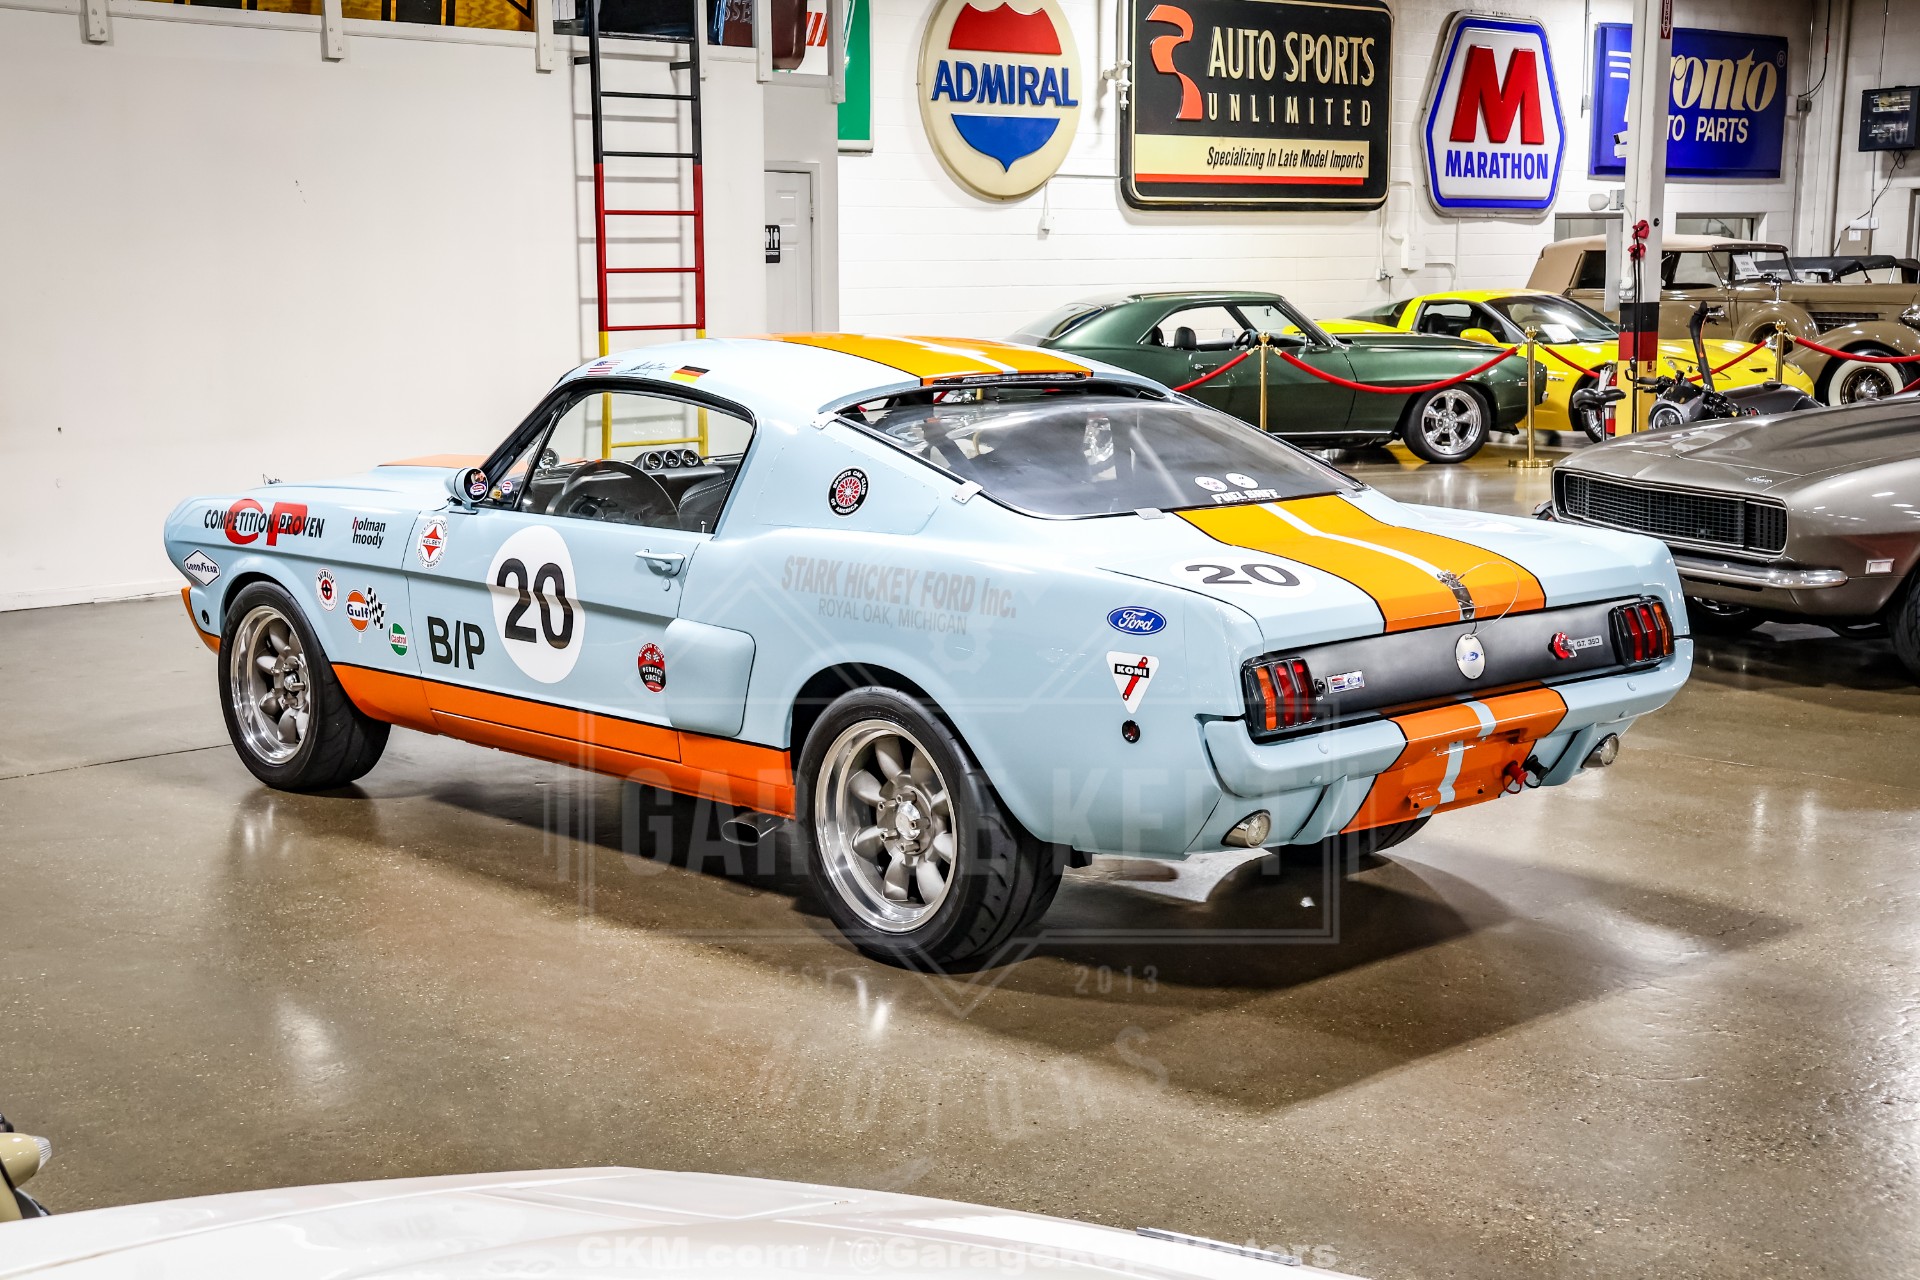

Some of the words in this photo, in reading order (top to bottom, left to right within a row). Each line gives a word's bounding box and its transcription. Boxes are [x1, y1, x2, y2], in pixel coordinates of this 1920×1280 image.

[1207, 26, 1277, 81] AUTO
[1283, 31, 1375, 87] SPORTS
[931, 60, 1079, 107] ADMIRAL
[1207, 92, 1371, 127] UNLIMITED
[1695, 116, 1749, 143] PARTS
[1207, 146, 1265, 170] Specializing
[1267, 150, 1276, 166] In
[1278, 148, 1299, 167] Late
[1300, 149, 1328, 168] Model
[1330, 150, 1364, 171] Imports
[1445, 150, 1549, 181] MARATHON
[832, 470, 852, 489] SPORTS
[852, 470, 864, 479] CAR
[834, 503, 859, 514] AMERICA
[204, 509, 276, 534] COMPETITION
[279, 515, 326, 539] PROVEN
[352, 517, 386, 533] holman
[352, 531, 384, 549] moody
[781, 555, 843, 597] STARK
[843, 562, 919, 605] HICKEY
[920, 571, 976, 613] FORD
[979, 577, 1017, 619] Inc.
[1184, 563, 1301, 587] 20
[347, 603, 369, 618] Gulf
[497, 558, 574, 650] 20
[818, 598, 860, 621] ROYAL
[862, 603, 894, 629] OAK,
[897, 608, 968, 636] MICHIGAN
[1118, 610, 1155, 631] Ford
[427, 616, 485, 670] B/P
[642, 666, 663, 677] PERFECT
[644, 673, 662, 684] CIRCLE
[1116, 665, 1147, 676] KONI
